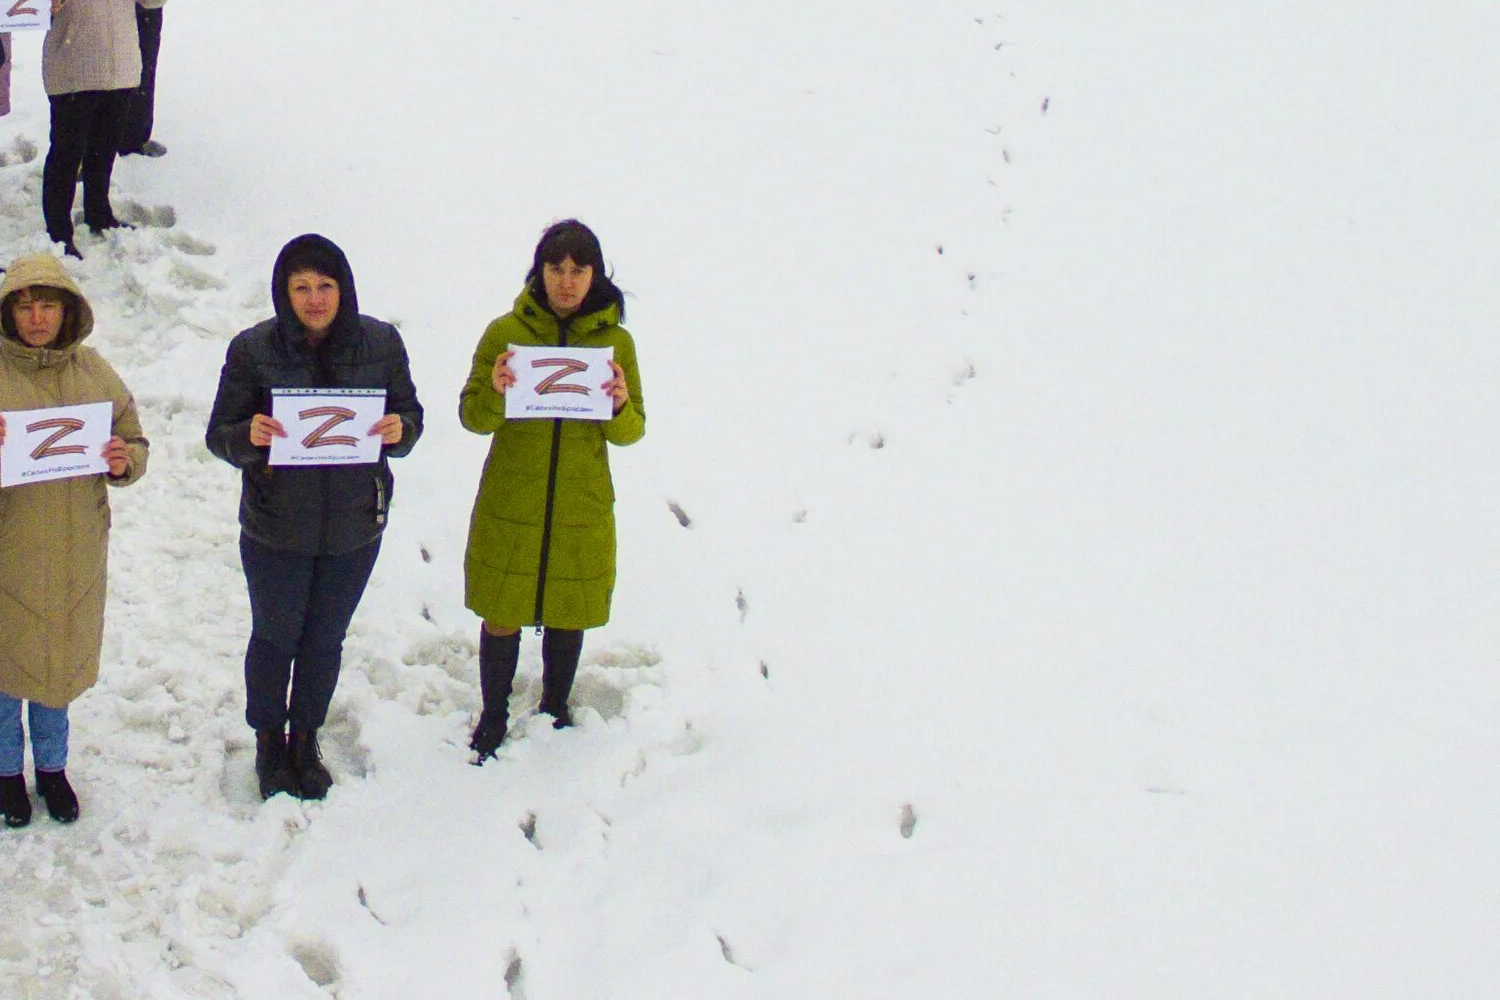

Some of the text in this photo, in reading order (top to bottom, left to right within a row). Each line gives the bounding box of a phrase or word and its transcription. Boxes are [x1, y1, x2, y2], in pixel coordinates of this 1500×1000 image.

[531, 358, 592, 397] Z
[26, 418, 90, 460] Z
[297, 406, 361, 449] Z
